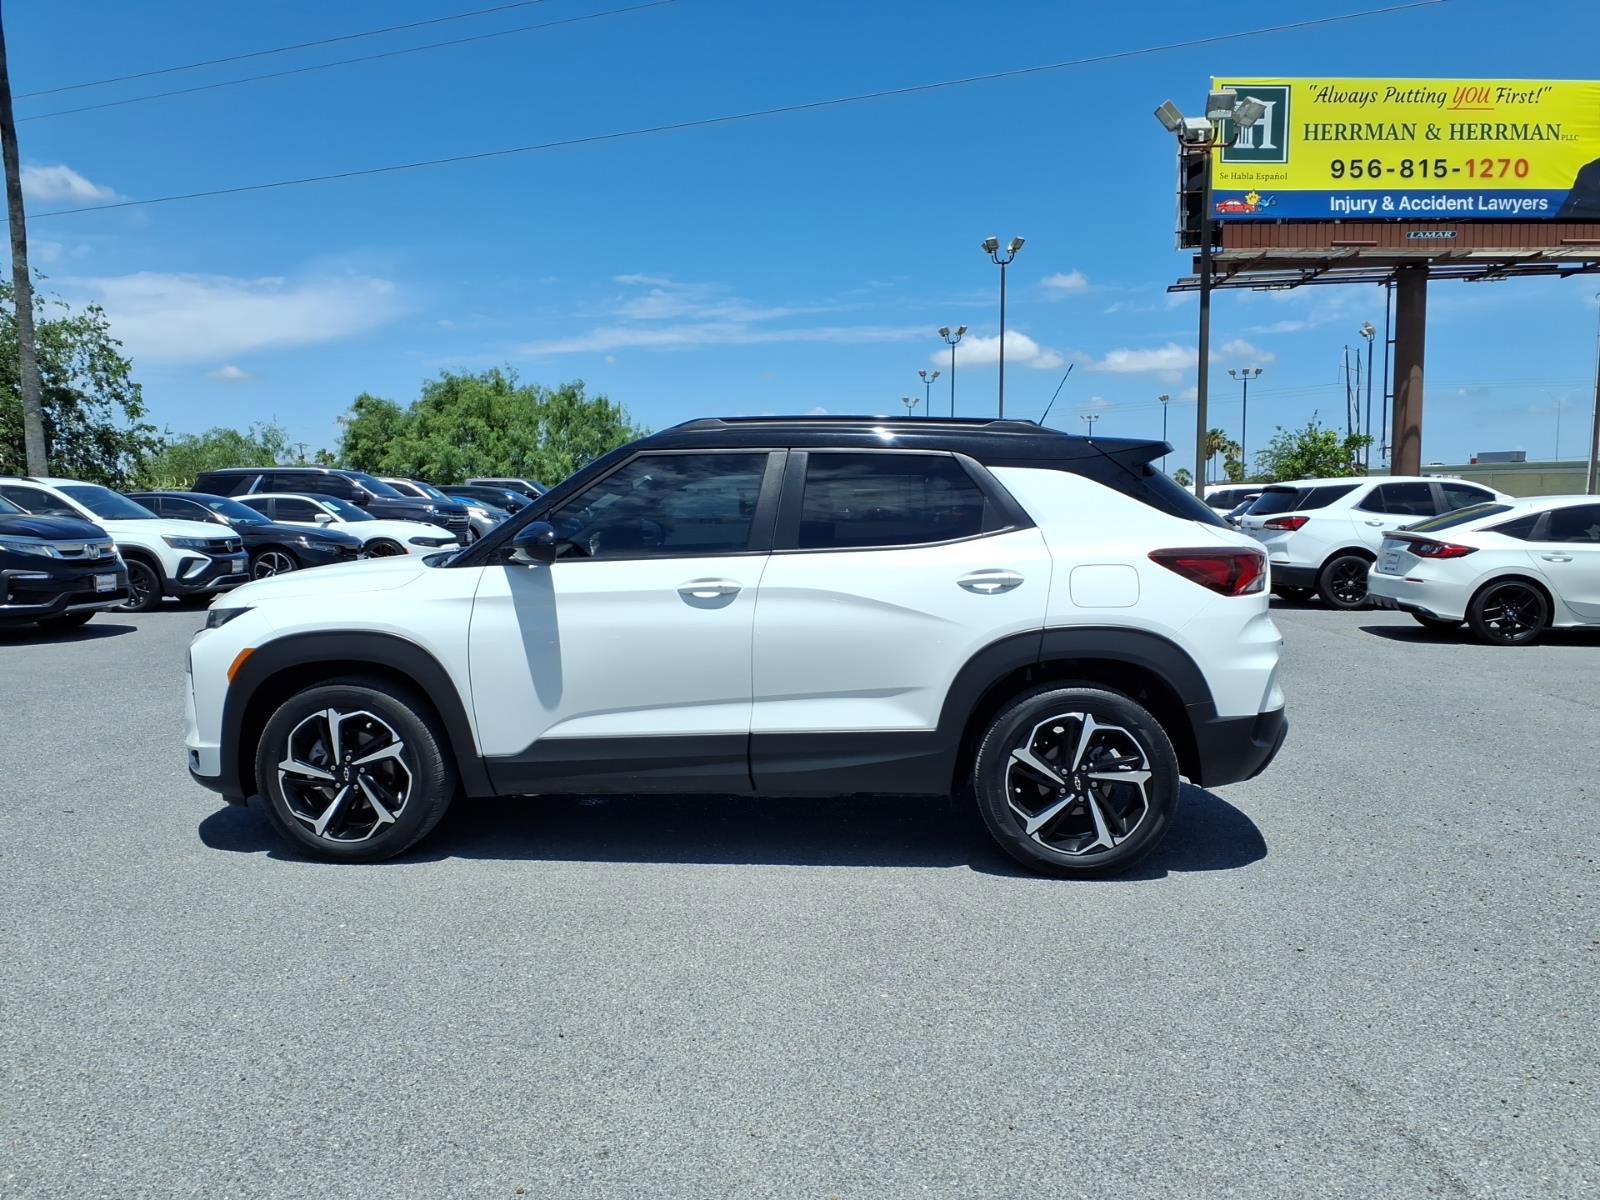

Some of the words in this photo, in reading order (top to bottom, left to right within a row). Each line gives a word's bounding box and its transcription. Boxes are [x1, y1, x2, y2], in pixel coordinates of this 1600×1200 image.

[1309, 85, 1378, 108] "Always
[1383, 86, 1447, 108] Putting
[1452, 86, 1491, 108] YOU
[1495, 86, 1552, 104] First!"
[1303, 123, 1416, 141] HERRMAN
[1425, 123, 1441, 141] &
[1449, 123, 1561, 141] HERRMAN
[1219, 172, 1228, 180] Se
[1230, 172, 1254, 180] Habla
[1256, 172, 1288, 181] Español
[1330, 158, 1529, 179] 956-815-1270
[1330, 196, 1377, 213] Injury
[1382, 196, 1394, 211] &
[1399, 195, 1474, 211] Accident
[1478, 196, 1548, 213] Lawyers
[1409, 231, 1454, 239] LAMAR
